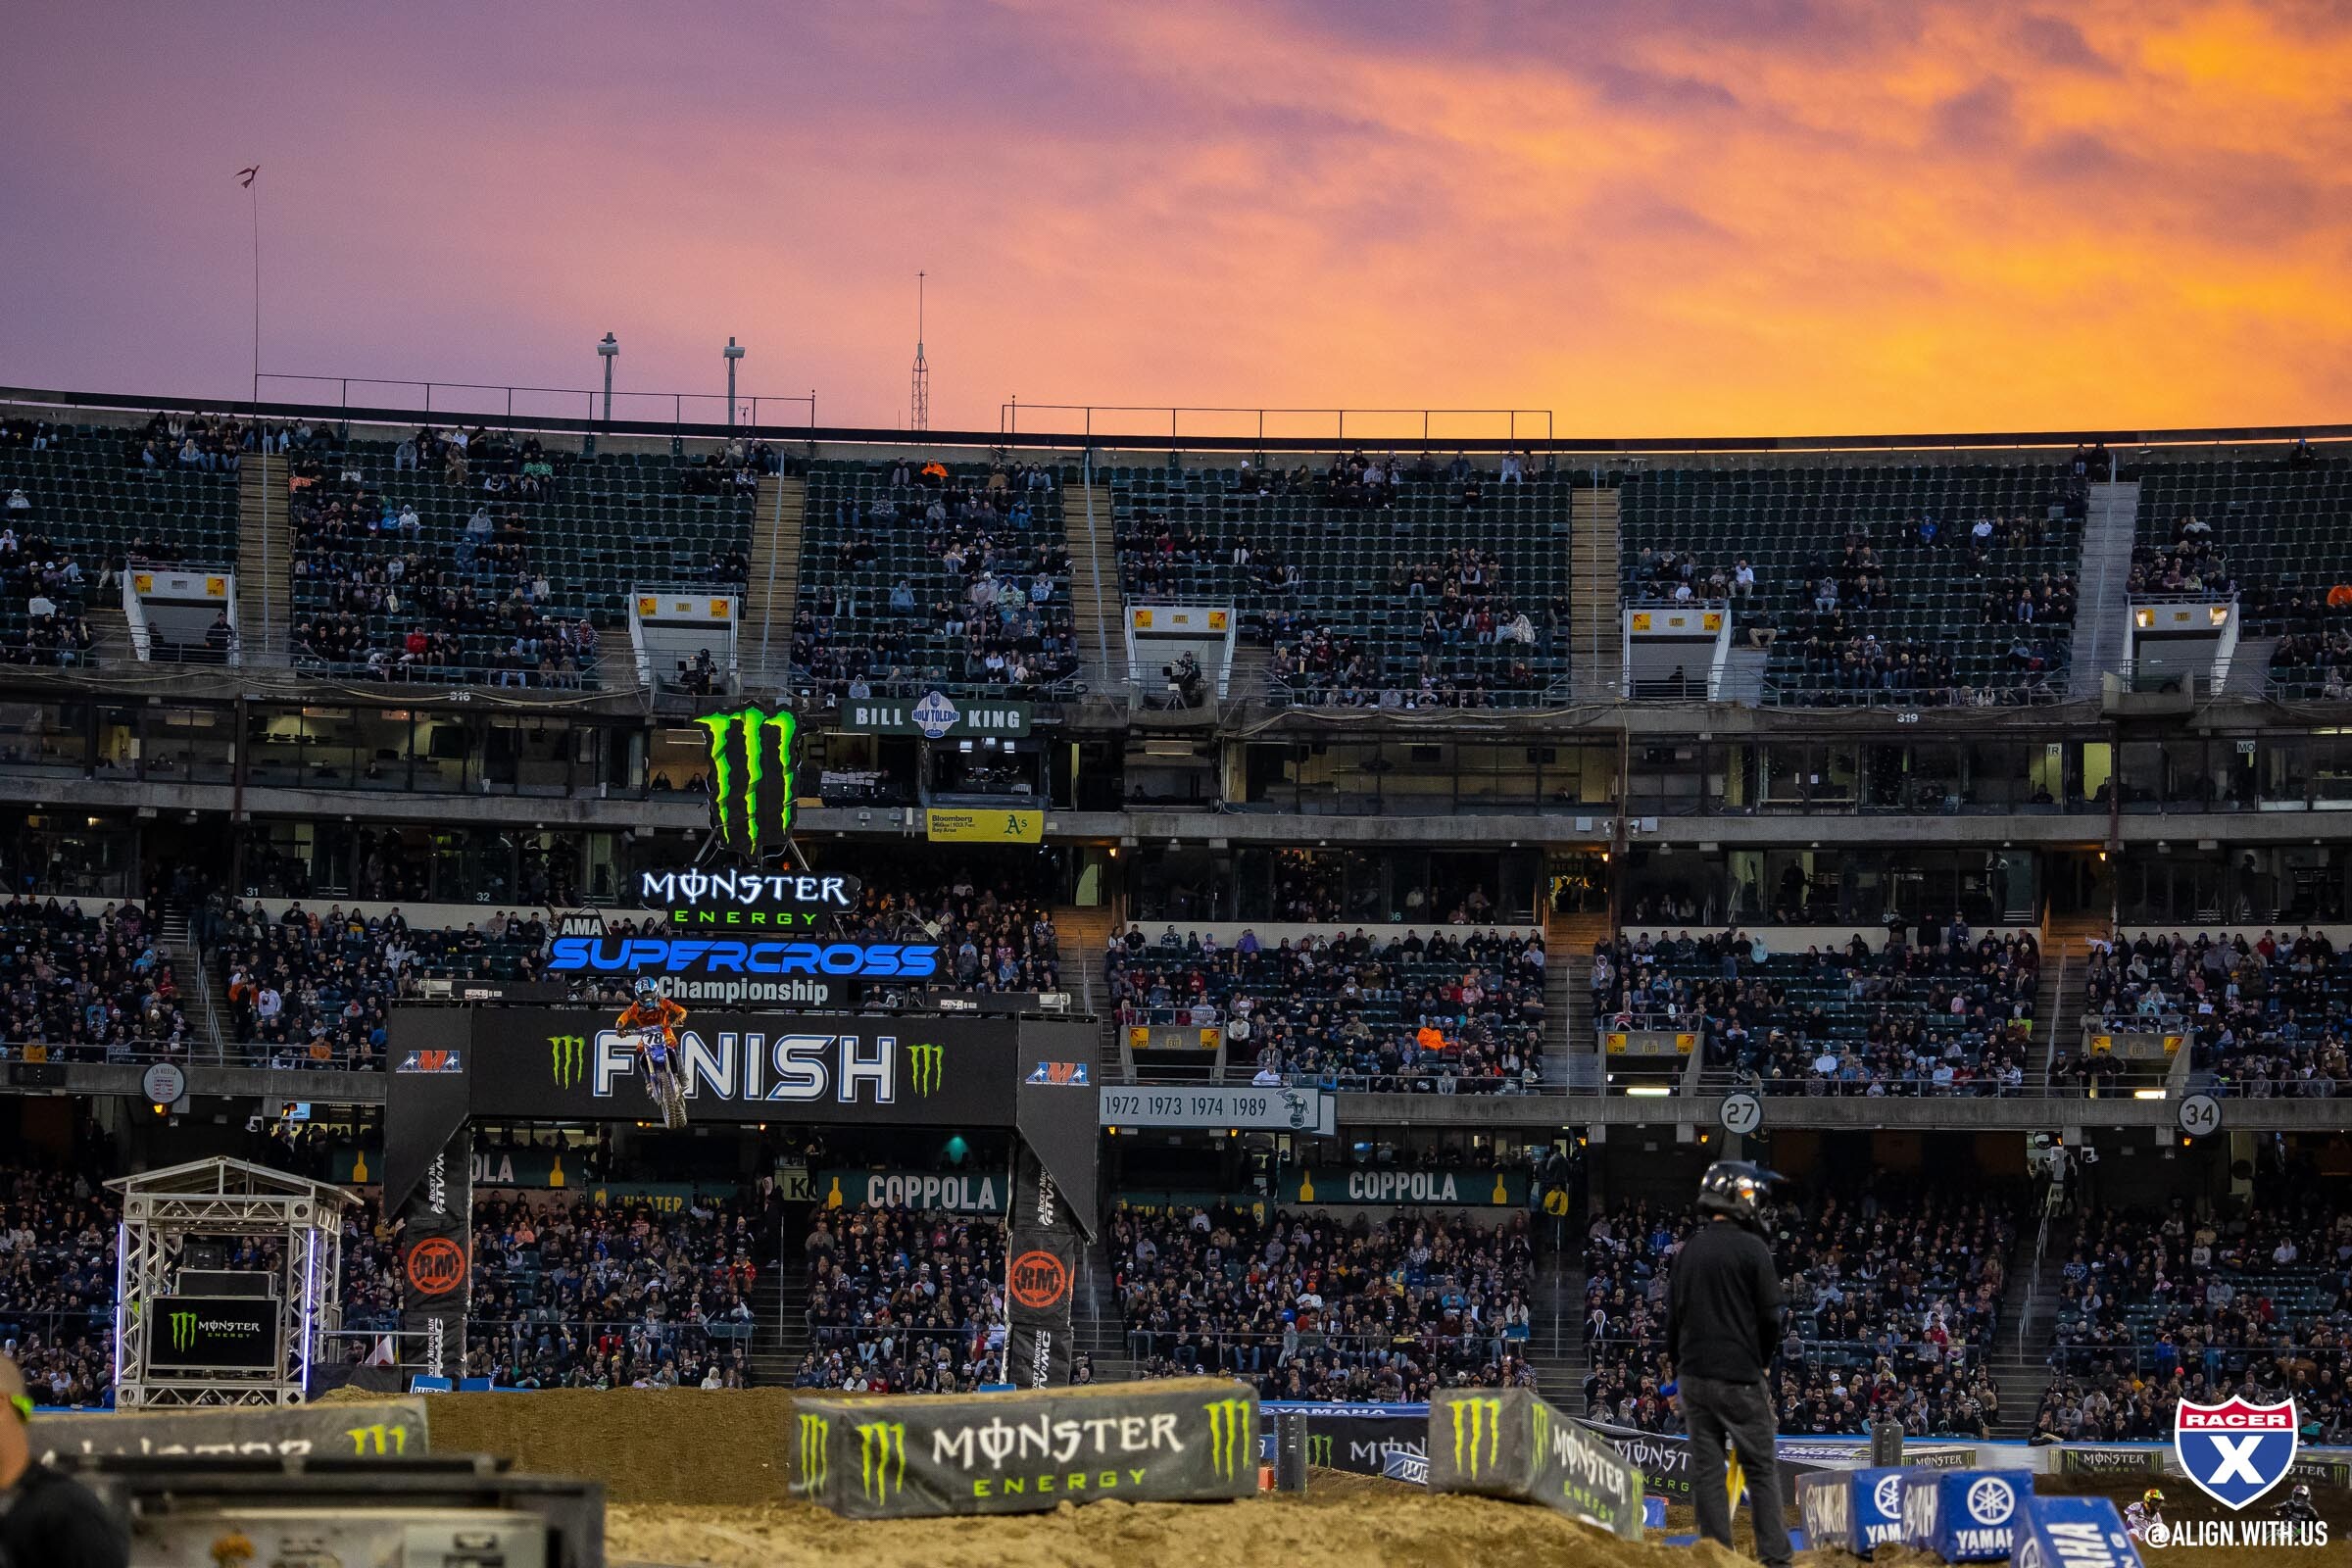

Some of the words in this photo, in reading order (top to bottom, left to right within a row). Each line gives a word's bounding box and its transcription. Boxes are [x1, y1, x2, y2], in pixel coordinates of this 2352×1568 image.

[450, 690, 470, 701] 316
[856, 708, 904, 725] BILL
[968, 710, 1020, 728] KING
[913, 709, 930, 722] HOLY
[931, 709, 959, 722] TOLEDO!
[1896, 713, 1919, 723] 319
[932, 814, 973, 823] Bloomberg
[1003, 814, 1028, 834] A's
[246, 887, 259, 897] 31
[642, 867, 851, 906] MONSTER
[476, 892, 491, 902] 32
[561, 918, 603, 936] AMA
[673, 909, 818, 925] ENERGY
[548, 938, 941, 977] SUPERCROSS
[659, 976, 829, 1005] Championship
[646, 1032, 663, 1045] 78
[396, 1050, 463, 1070] AMA
[592, 1029, 898, 1104] FNISH
[1026, 1061, 1091, 1082] AMA
[1105, 1096, 1140, 1114] 1972
[1149, 1097, 1182, 1115] 1973
[1191, 1097, 1224, 1115] 1974
[1232, 1098, 1266, 1116] 1989
[1726, 1102, 1755, 1124] 27
[2185, 1103, 2215, 1126] 34
[867, 1175, 997, 1210] COPPOLA
[1348, 1171, 1458, 1201] COPPOLA
[198, 1319, 262, 1333] MONSTER
[932, 1412, 1185, 1470] MONSTER
[1553, 1424, 1626, 1505] MONSTER
[1614, 1440, 1692, 1473] MONST
[1915, 1454, 1963, 1467] MONSTER
[2083, 1451, 2145, 1466] MONSTER
[972, 1467, 1147, 1497] ENERGY
[1641, 1474, 1690, 1493] NERG
